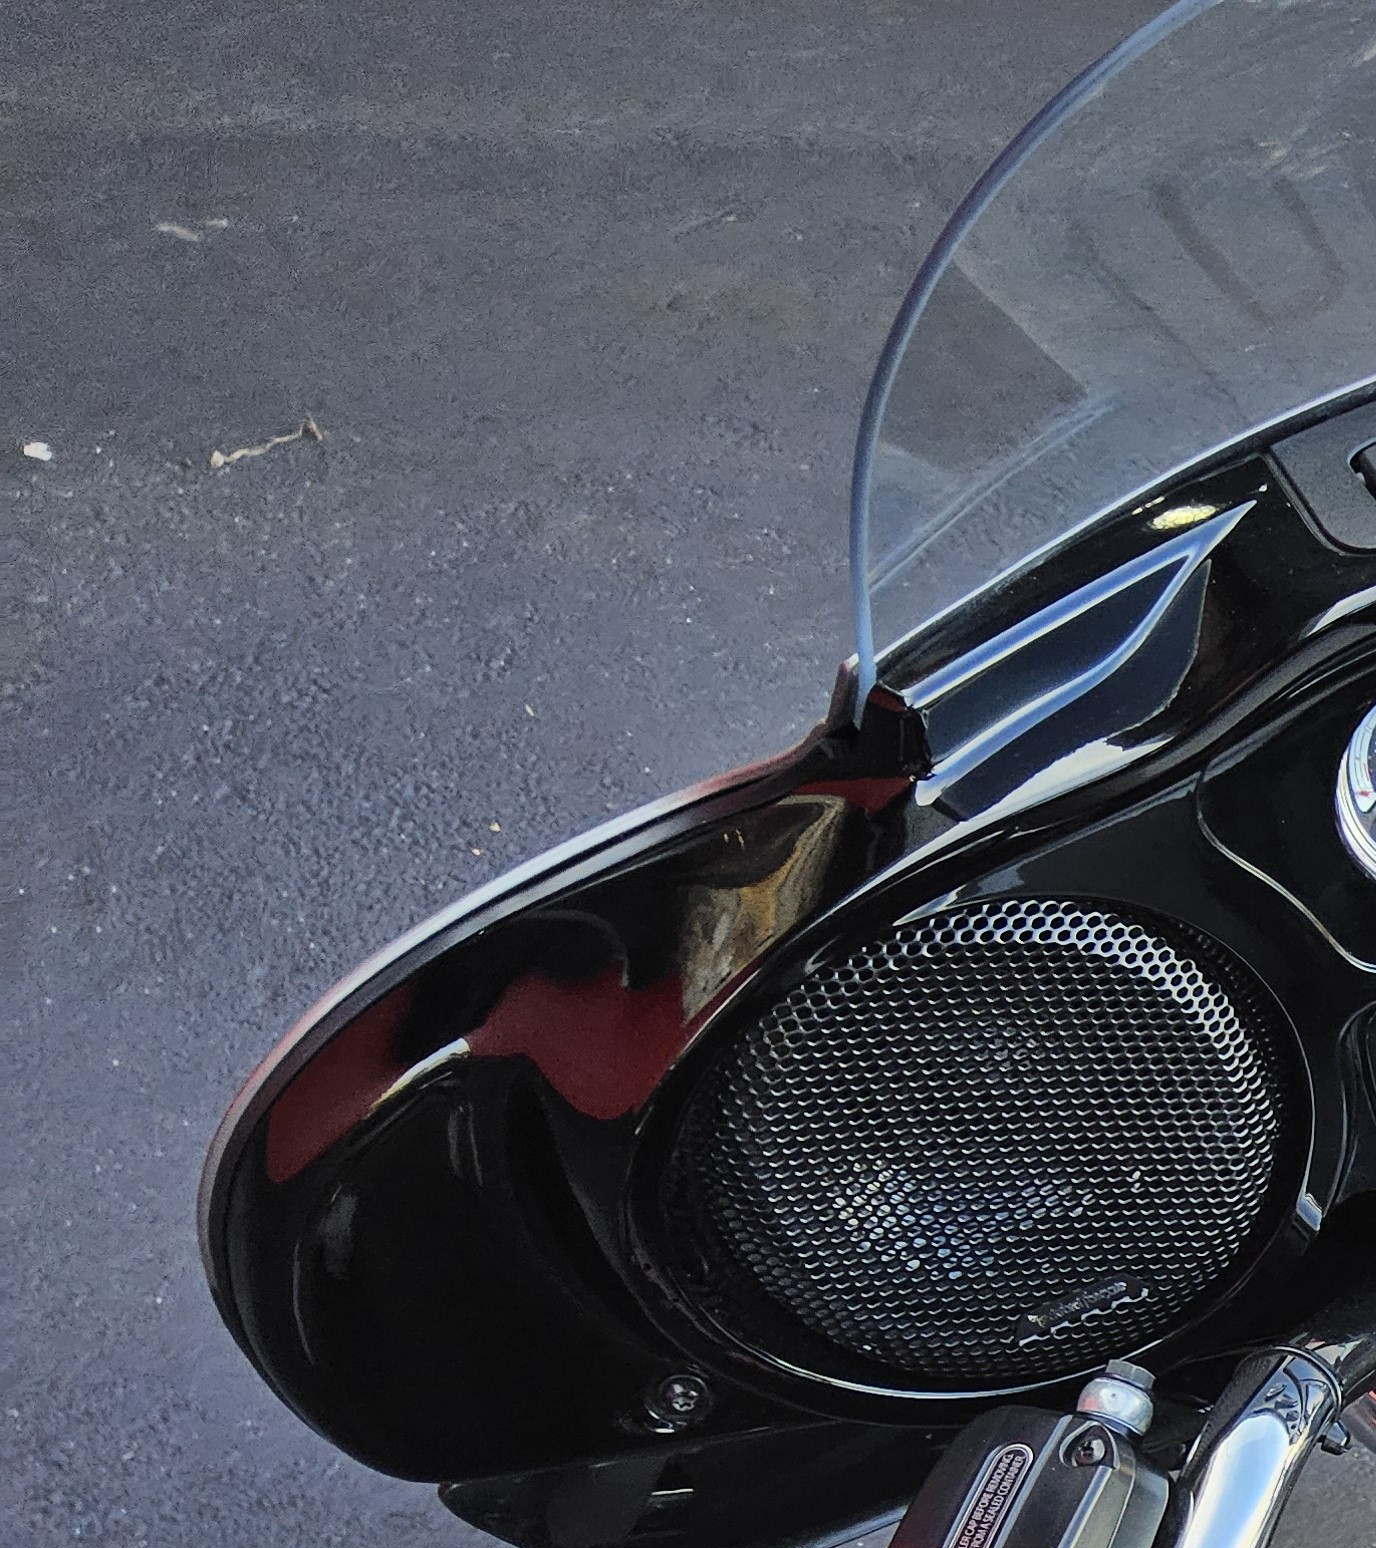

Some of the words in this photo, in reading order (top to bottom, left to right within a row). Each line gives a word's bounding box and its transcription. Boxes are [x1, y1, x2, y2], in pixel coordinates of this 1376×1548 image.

[965, 1520, 977, 1535] CAP
[972, 1492, 992, 1520] BEFORE
[984, 1496, 1004, 1522] SEALED
[998, 1455, 1025, 1495] CONTAINER
